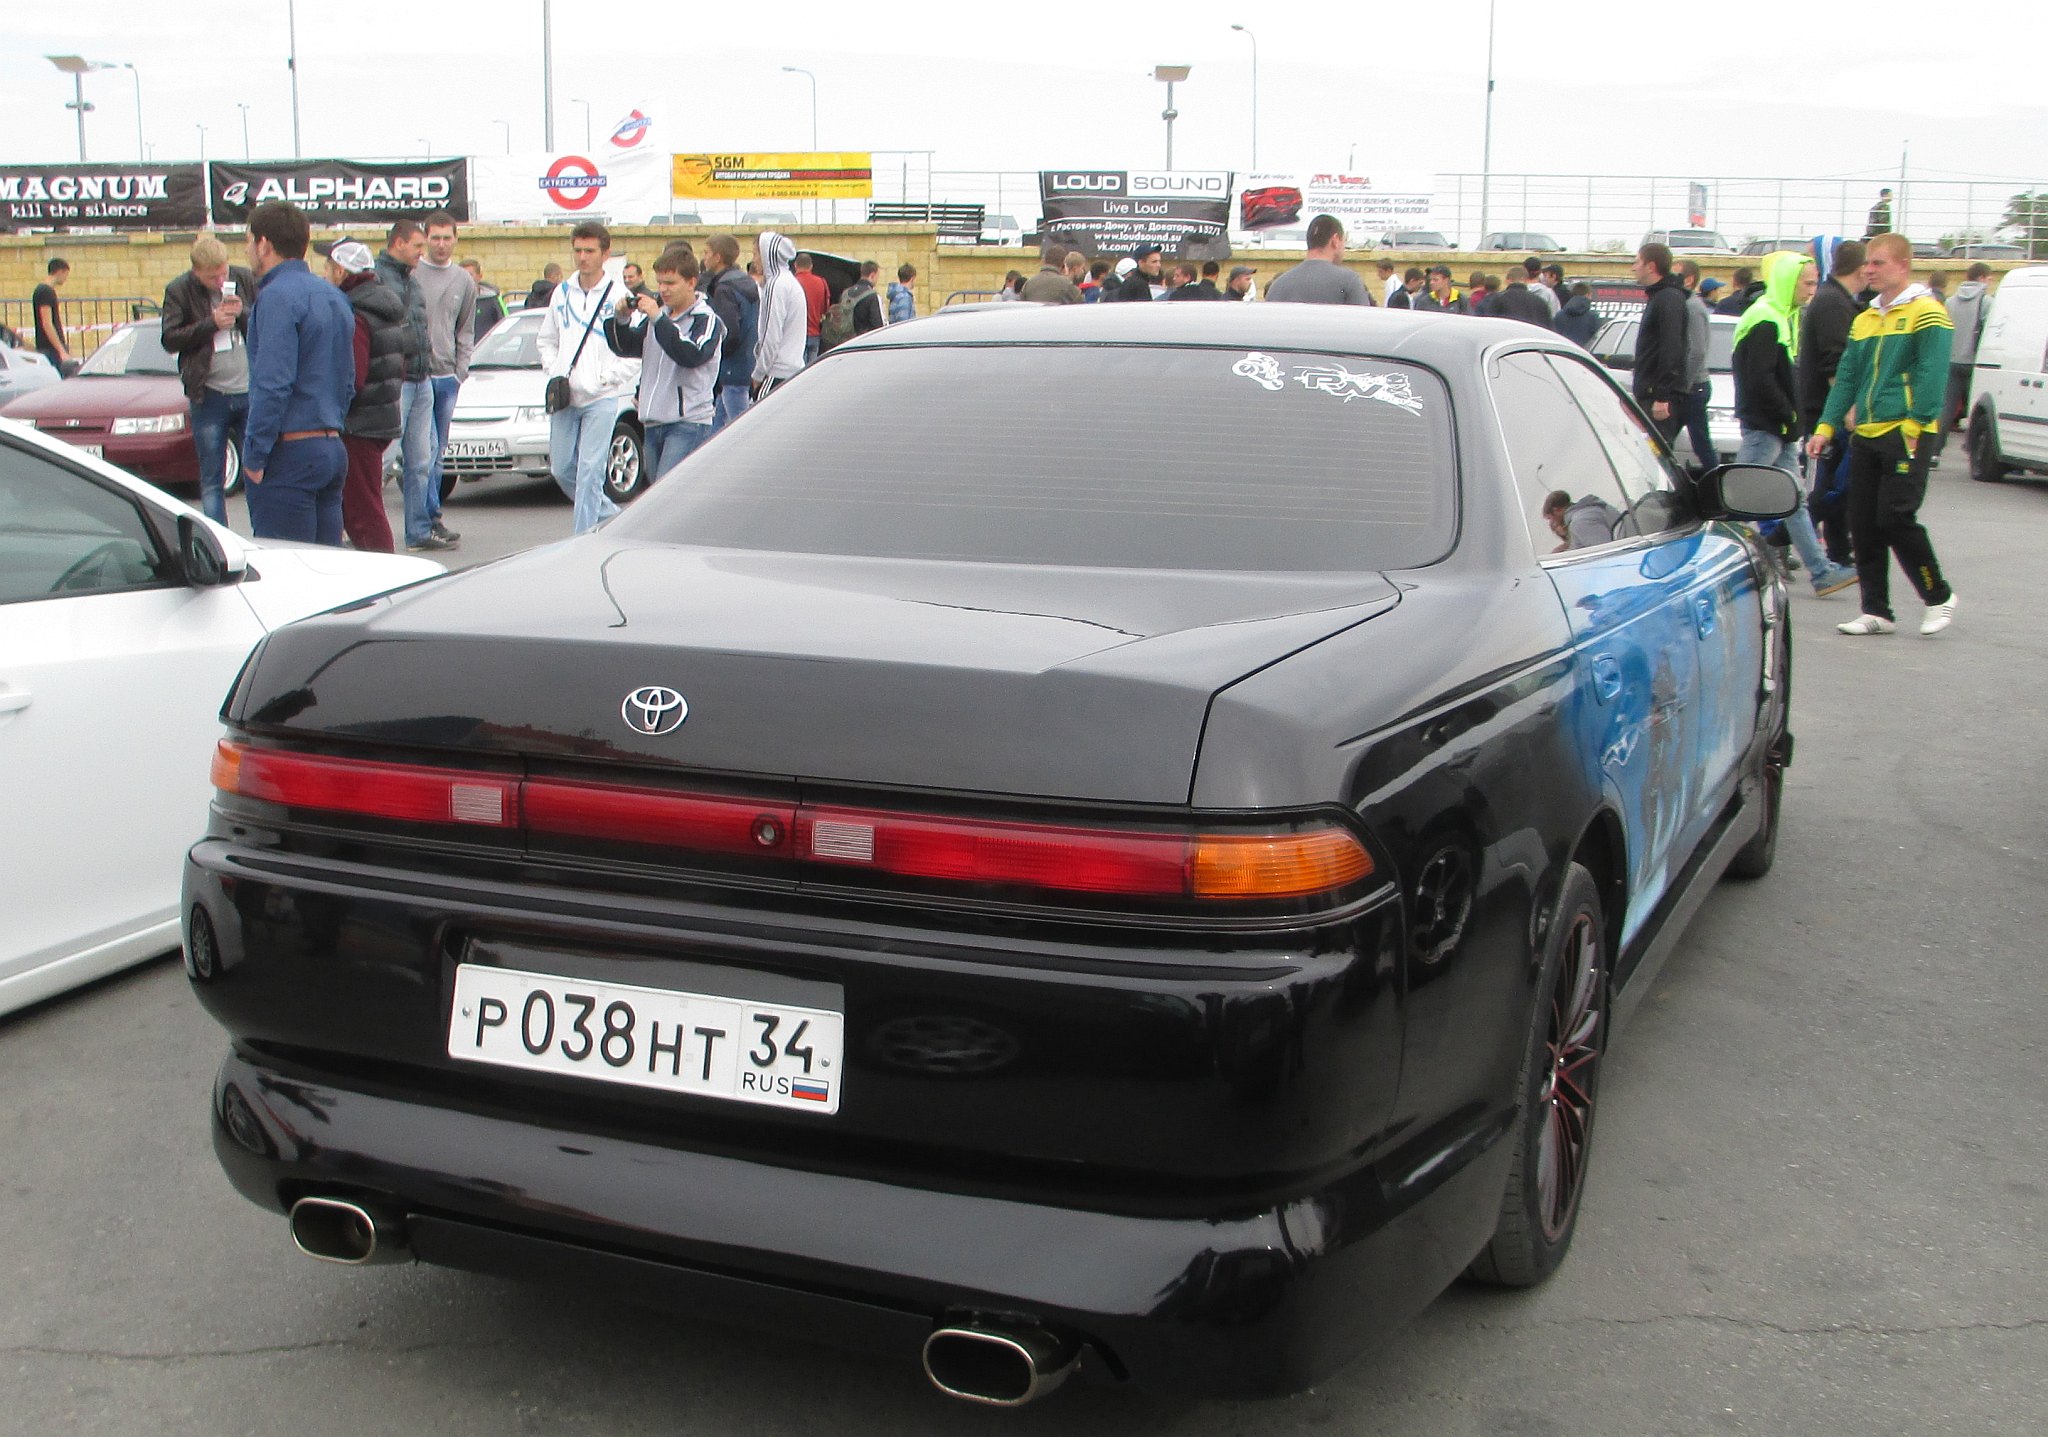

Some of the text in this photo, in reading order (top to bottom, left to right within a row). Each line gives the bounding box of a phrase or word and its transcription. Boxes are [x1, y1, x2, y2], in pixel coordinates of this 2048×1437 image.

[715, 157, 745, 168] SGM
[0, 175, 168, 200] MAGNUM
[256, 176, 450, 200] ALPHARD
[540, 176, 607, 187] EXTREME SOUND
[1053, 175, 1222, 190] LOUD SOUND
[11, 202, 148, 218] kill the silence
[325, 199, 450, 210] TECHNOLOGY
[1104, 200, 1168, 214] Live Loud
[1133, 223, 1147, 232] ул.
[1094, 231, 1182, 243] www.loudsound.su
[749, 1013, 814, 1074] 34
[742, 1072, 790, 1095] RUS
